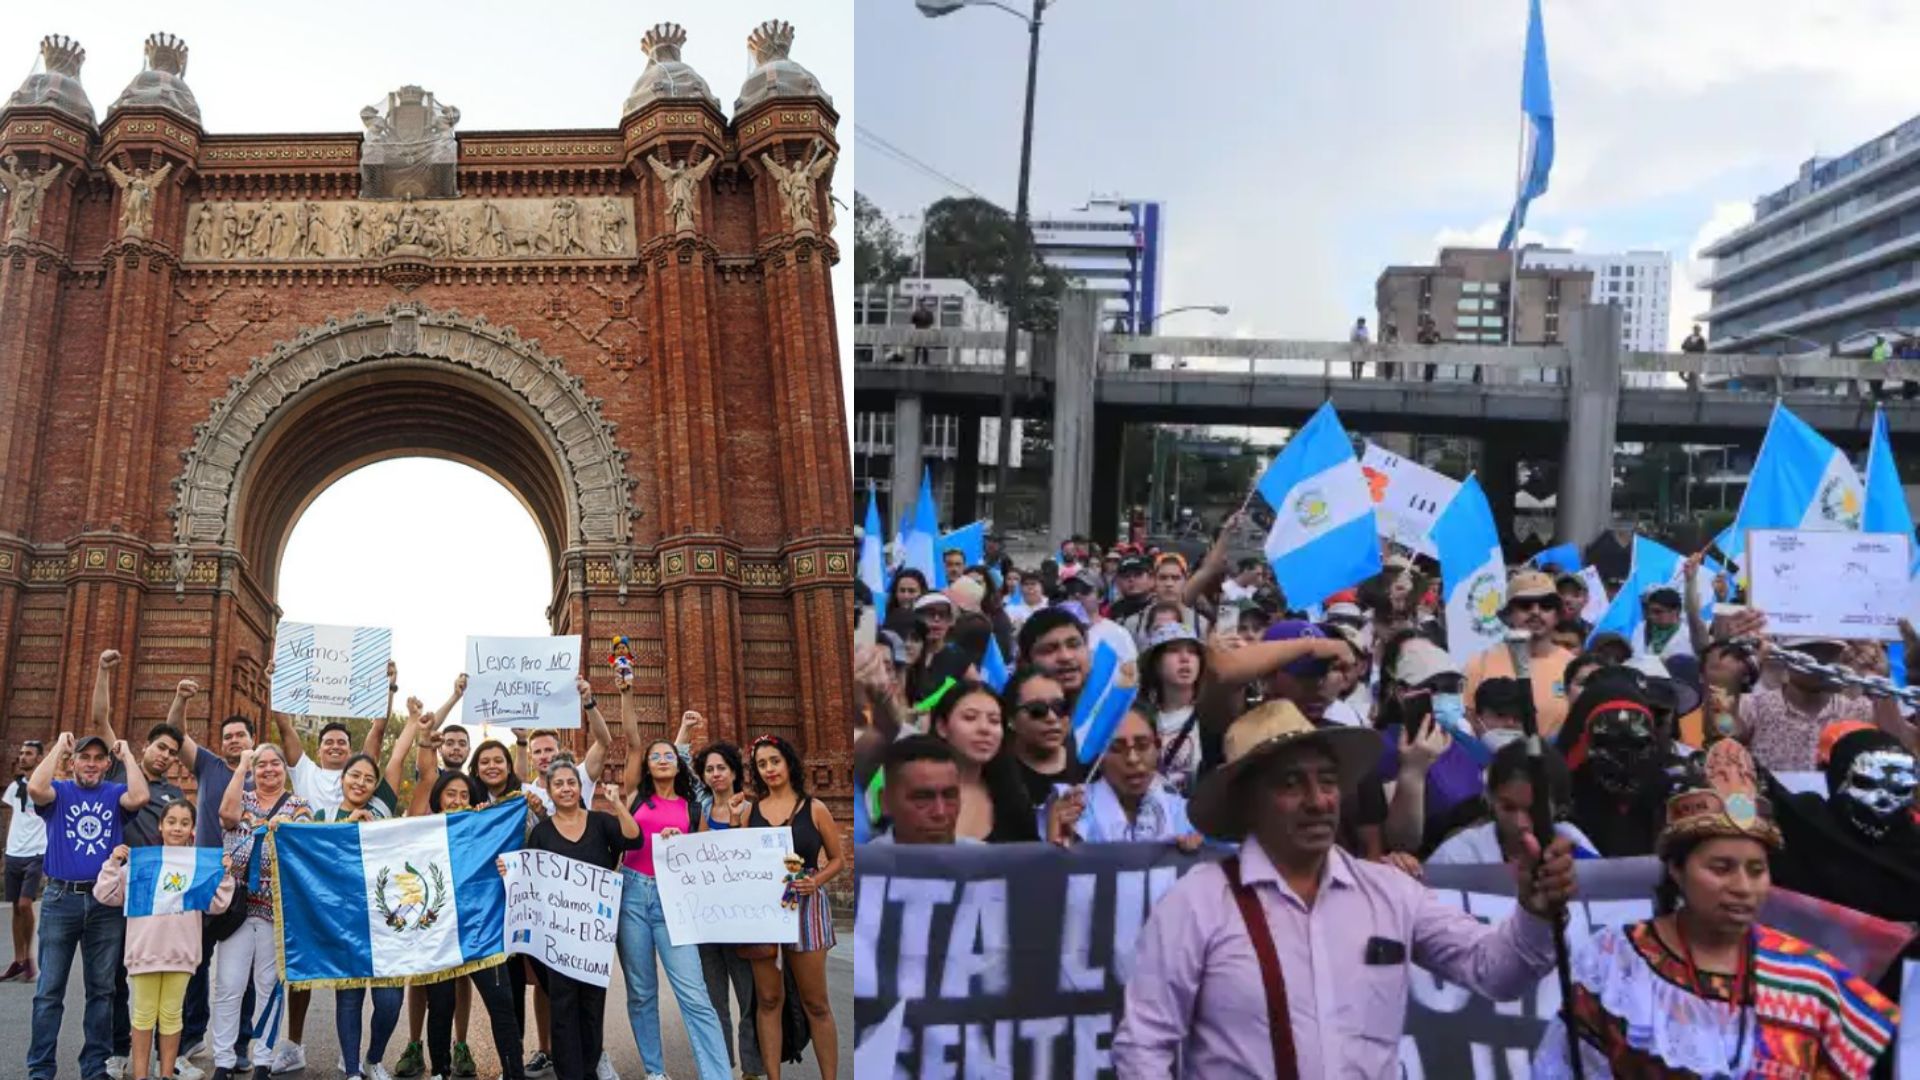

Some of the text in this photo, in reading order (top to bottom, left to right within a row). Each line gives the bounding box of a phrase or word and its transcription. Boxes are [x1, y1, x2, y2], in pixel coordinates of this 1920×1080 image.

[289, 640, 349, 664] Vamos
[549, 651, 572, 671] NO
[493, 681, 551, 697] AUSENTES
[65, 800, 113, 823] IDAHO
[66, 829, 113, 856] STATE
[666, 845, 691, 873] En
[681, 872, 696, 885] de
[701, 870, 715, 885] la
[508, 881, 593, 915] Guate estamos
[549, 910, 575, 934] desde
[580, 922, 591, 942] El
